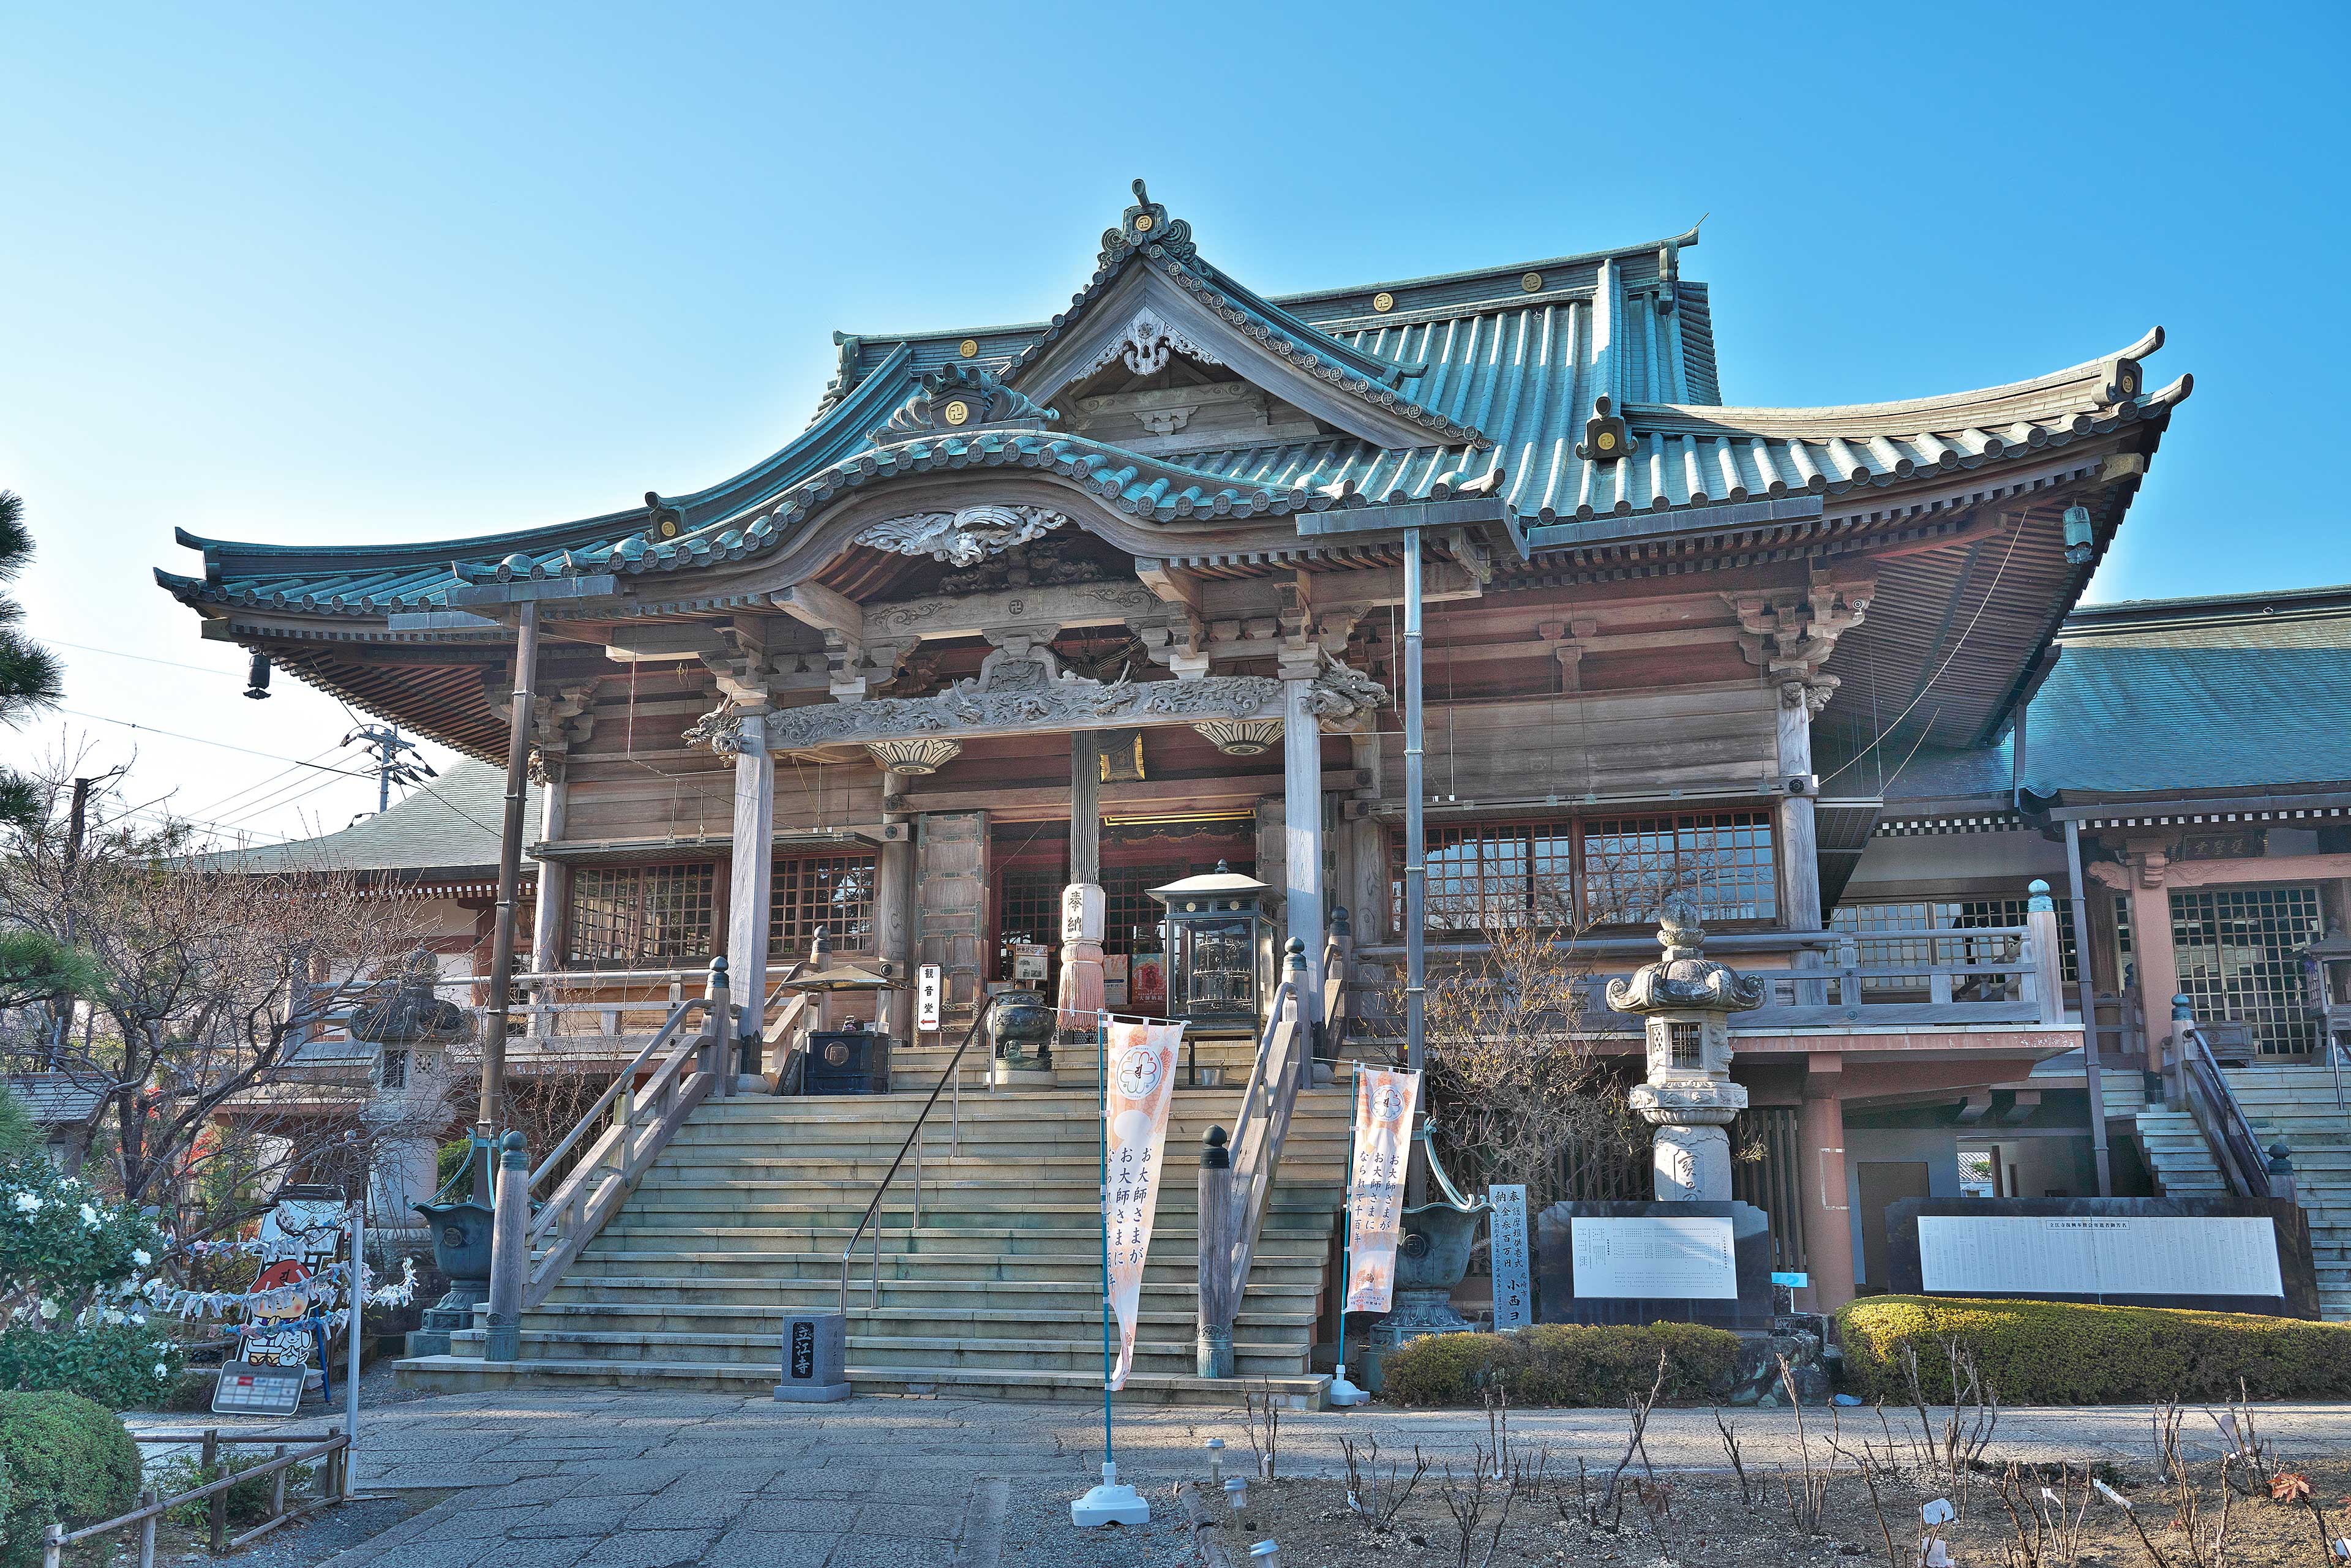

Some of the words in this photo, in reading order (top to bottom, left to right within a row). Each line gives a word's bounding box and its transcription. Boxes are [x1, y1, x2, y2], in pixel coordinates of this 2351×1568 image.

[1068, 891, 1082, 932] 奉納
[924, 968, 934, 1013] 観音堂
[1114, 1147, 1133, 1266] お大師さまに
[1129, 1147, 1152, 1264] お大師さまが
[1354, 1150, 1369, 1244] なられて千百年
[1365, 1152, 1384, 1229] お大師さまに
[1379, 1155, 1400, 1231] お大師さまが
[795, 1325, 812, 1375] 立江寺
